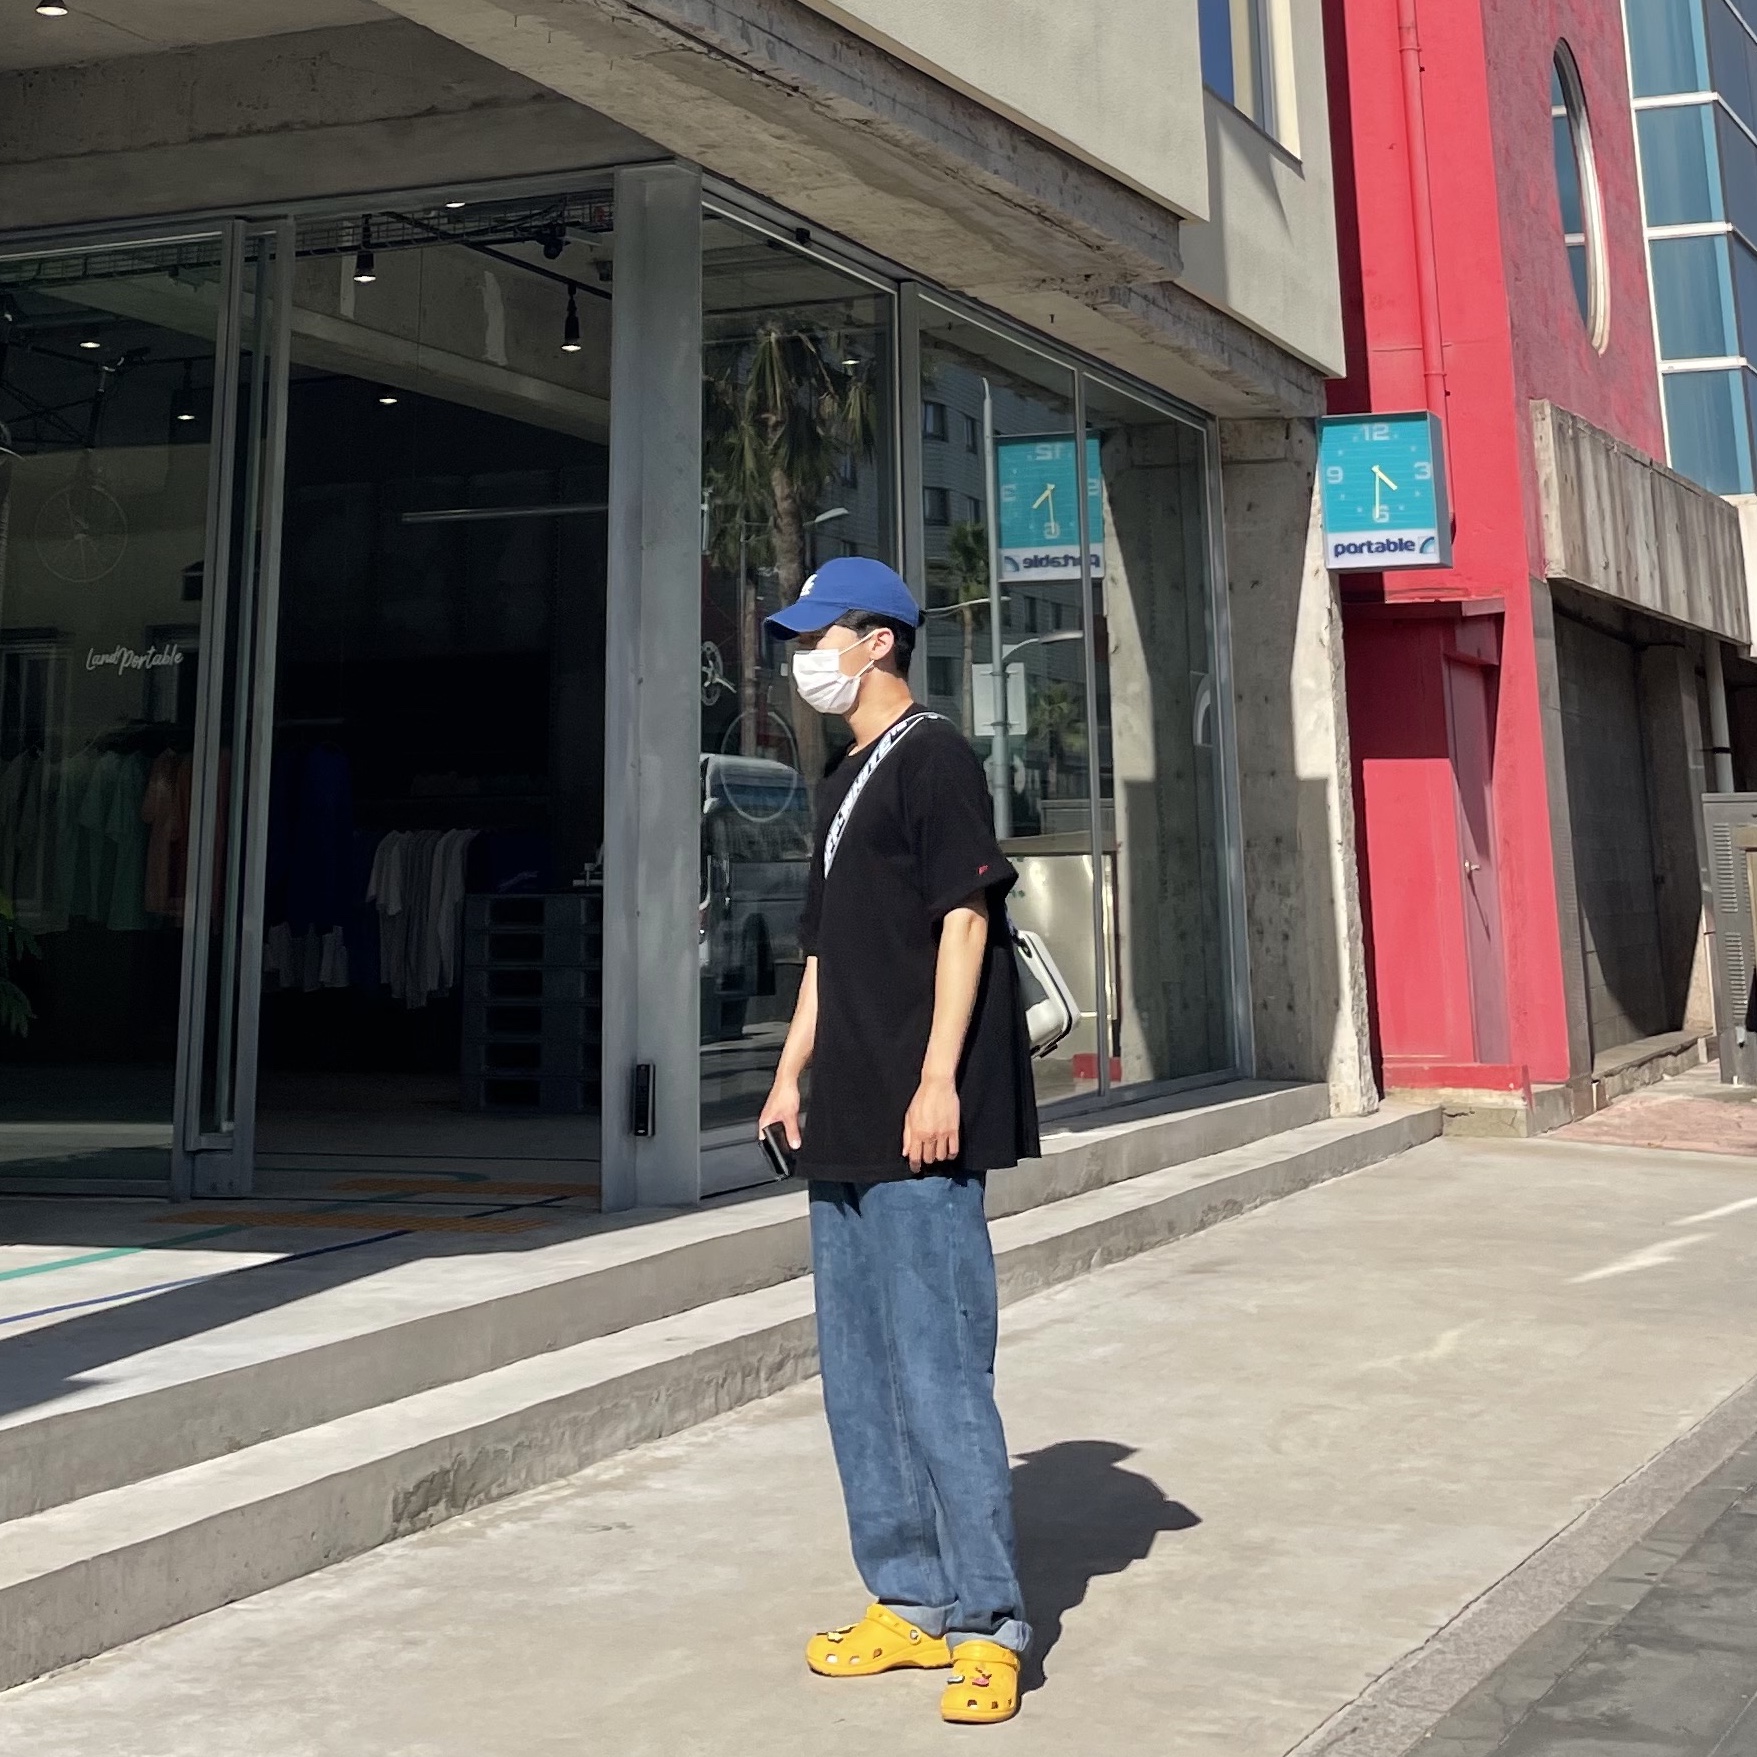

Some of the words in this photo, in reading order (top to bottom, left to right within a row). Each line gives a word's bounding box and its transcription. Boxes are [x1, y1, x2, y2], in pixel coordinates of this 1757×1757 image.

[1361, 423, 1391, 442] 12
[1326, 466, 1344, 484] 9
[1414, 461, 1432, 480] 3
[1372, 504, 1390, 524] 6
[1333, 537, 1416, 558] portable
